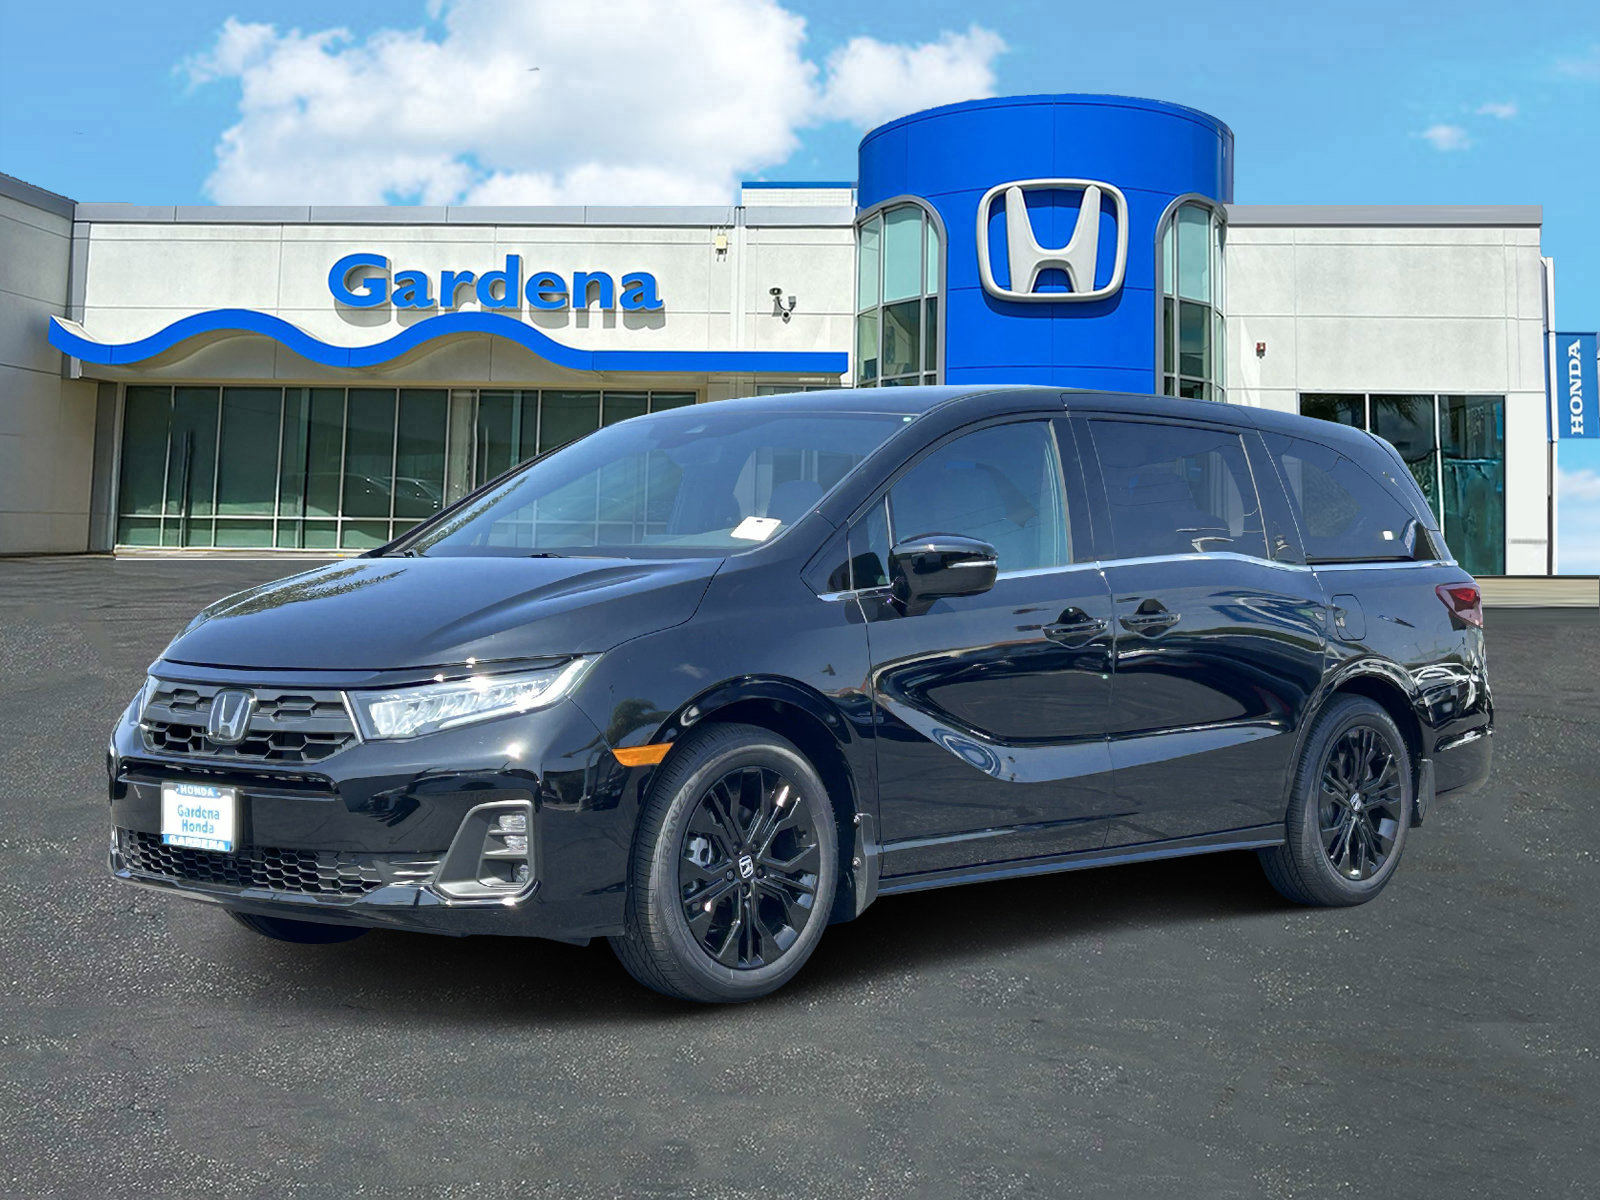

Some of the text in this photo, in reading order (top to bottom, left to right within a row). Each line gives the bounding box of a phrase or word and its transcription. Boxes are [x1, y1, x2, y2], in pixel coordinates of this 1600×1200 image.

[328, 253, 664, 310] Gardena
[1568, 339, 1584, 435] HONDA
[180, 784, 215, 796] HONDA
[177, 804, 220, 820] Gardena
[181, 819, 215, 833] Honda
